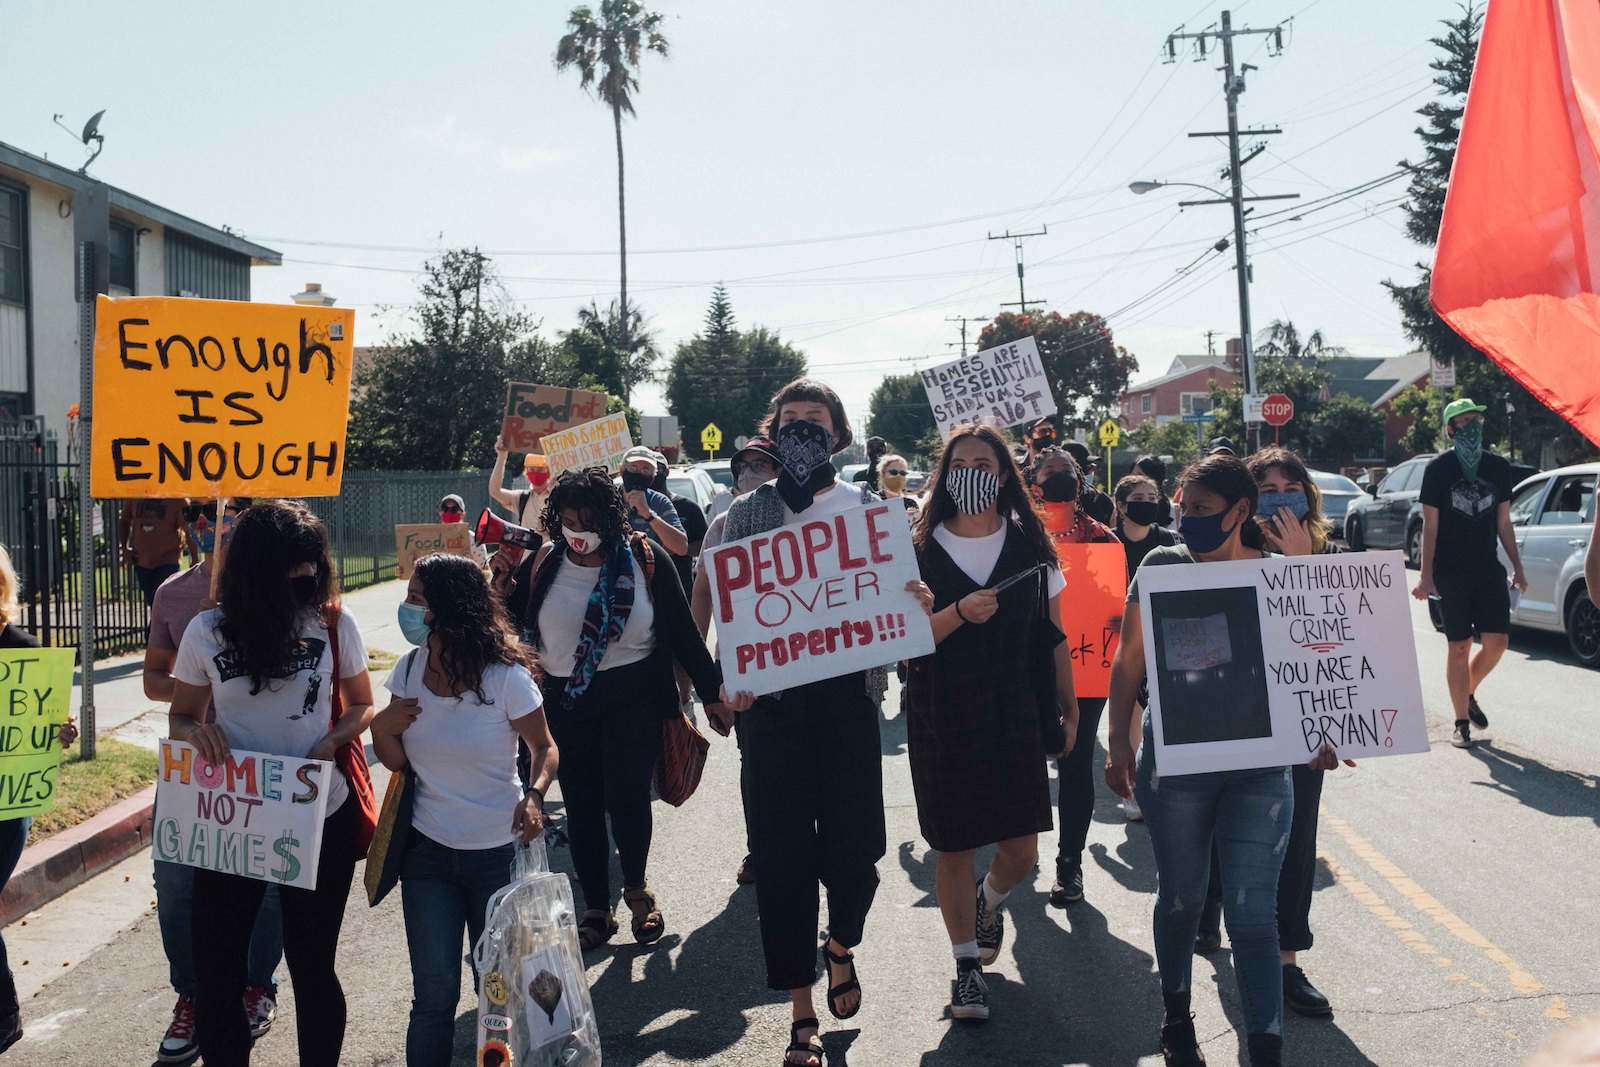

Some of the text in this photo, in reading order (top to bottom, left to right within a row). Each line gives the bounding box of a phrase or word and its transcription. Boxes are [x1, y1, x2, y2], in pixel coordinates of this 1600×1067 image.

[119, 318, 334, 401] Enough
[993, 344, 1020, 364] ARE
[940, 354, 1042, 401] ESSENTIAL
[174, 389, 264, 426] IS
[508, 384, 600, 422] Food not
[934, 383, 1026, 422] STADIUMS
[1264, 403, 1292, 416] STOP
[579, 427, 590, 445] IS
[590, 443, 603, 460] THE
[111, 437, 338, 483] ENOUGH
[713, 506, 893, 623] PEOPLE
[1261, 563, 1392, 591] WITHHOLDING
[755, 571, 880, 627] OVER
[1266, 592, 1373, 617] MAIL IS A
[1289, 617, 1355, 644] CRIME
[1269, 656, 1375, 685] YOU ARE A
[1292, 685, 1359, 715] THIEF
[31, 723, 62, 751] UP
[1301, 709, 1398, 752] BRYAN!
[162, 743, 322, 804] HOMES
[198, 791, 263, 828] NOT
[484, 1017, 508, 1028] QUEEN
